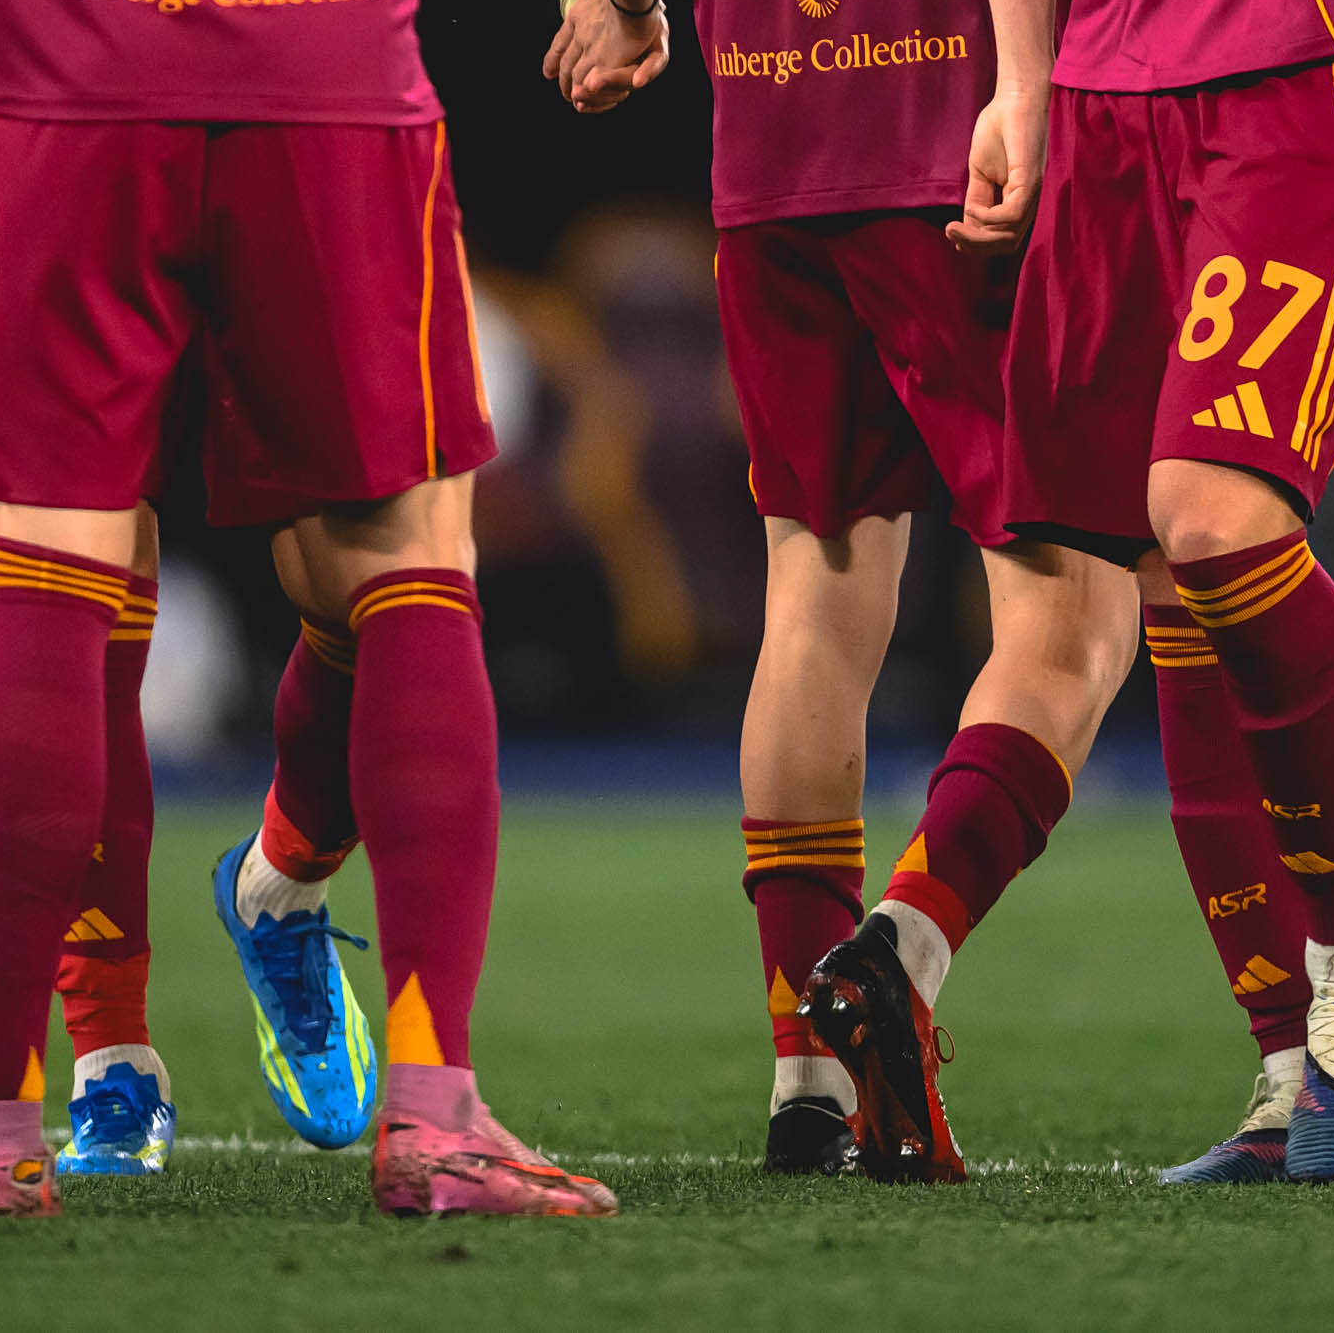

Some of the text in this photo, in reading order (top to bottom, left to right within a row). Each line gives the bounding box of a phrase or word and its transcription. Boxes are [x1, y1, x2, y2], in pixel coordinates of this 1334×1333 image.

[810, 29, 968, 72] Collection
[1178, 254, 1326, 370] 87
[1208, 882, 1267, 920] ASR
